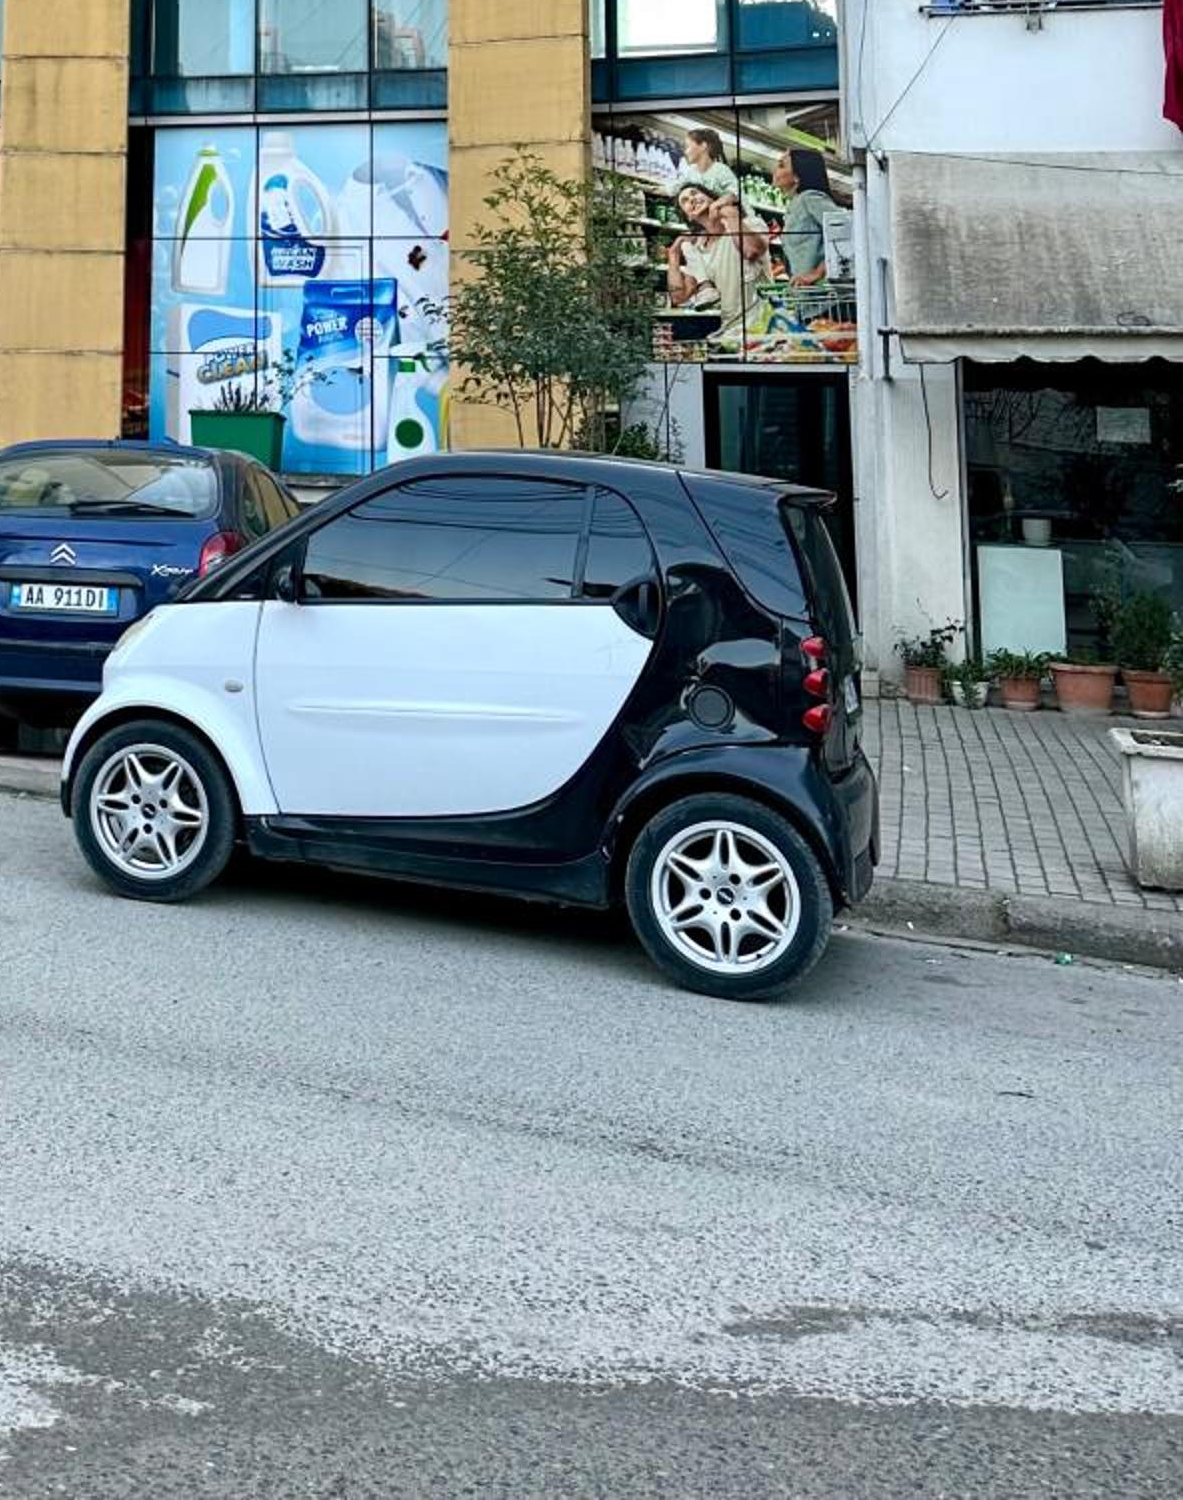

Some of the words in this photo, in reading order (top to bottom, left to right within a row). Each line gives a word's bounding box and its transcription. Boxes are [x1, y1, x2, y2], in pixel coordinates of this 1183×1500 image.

[306, 316, 348, 338] POWER
[25, 586, 44, 604] AA
[54, 587, 104, 608] 911DI
